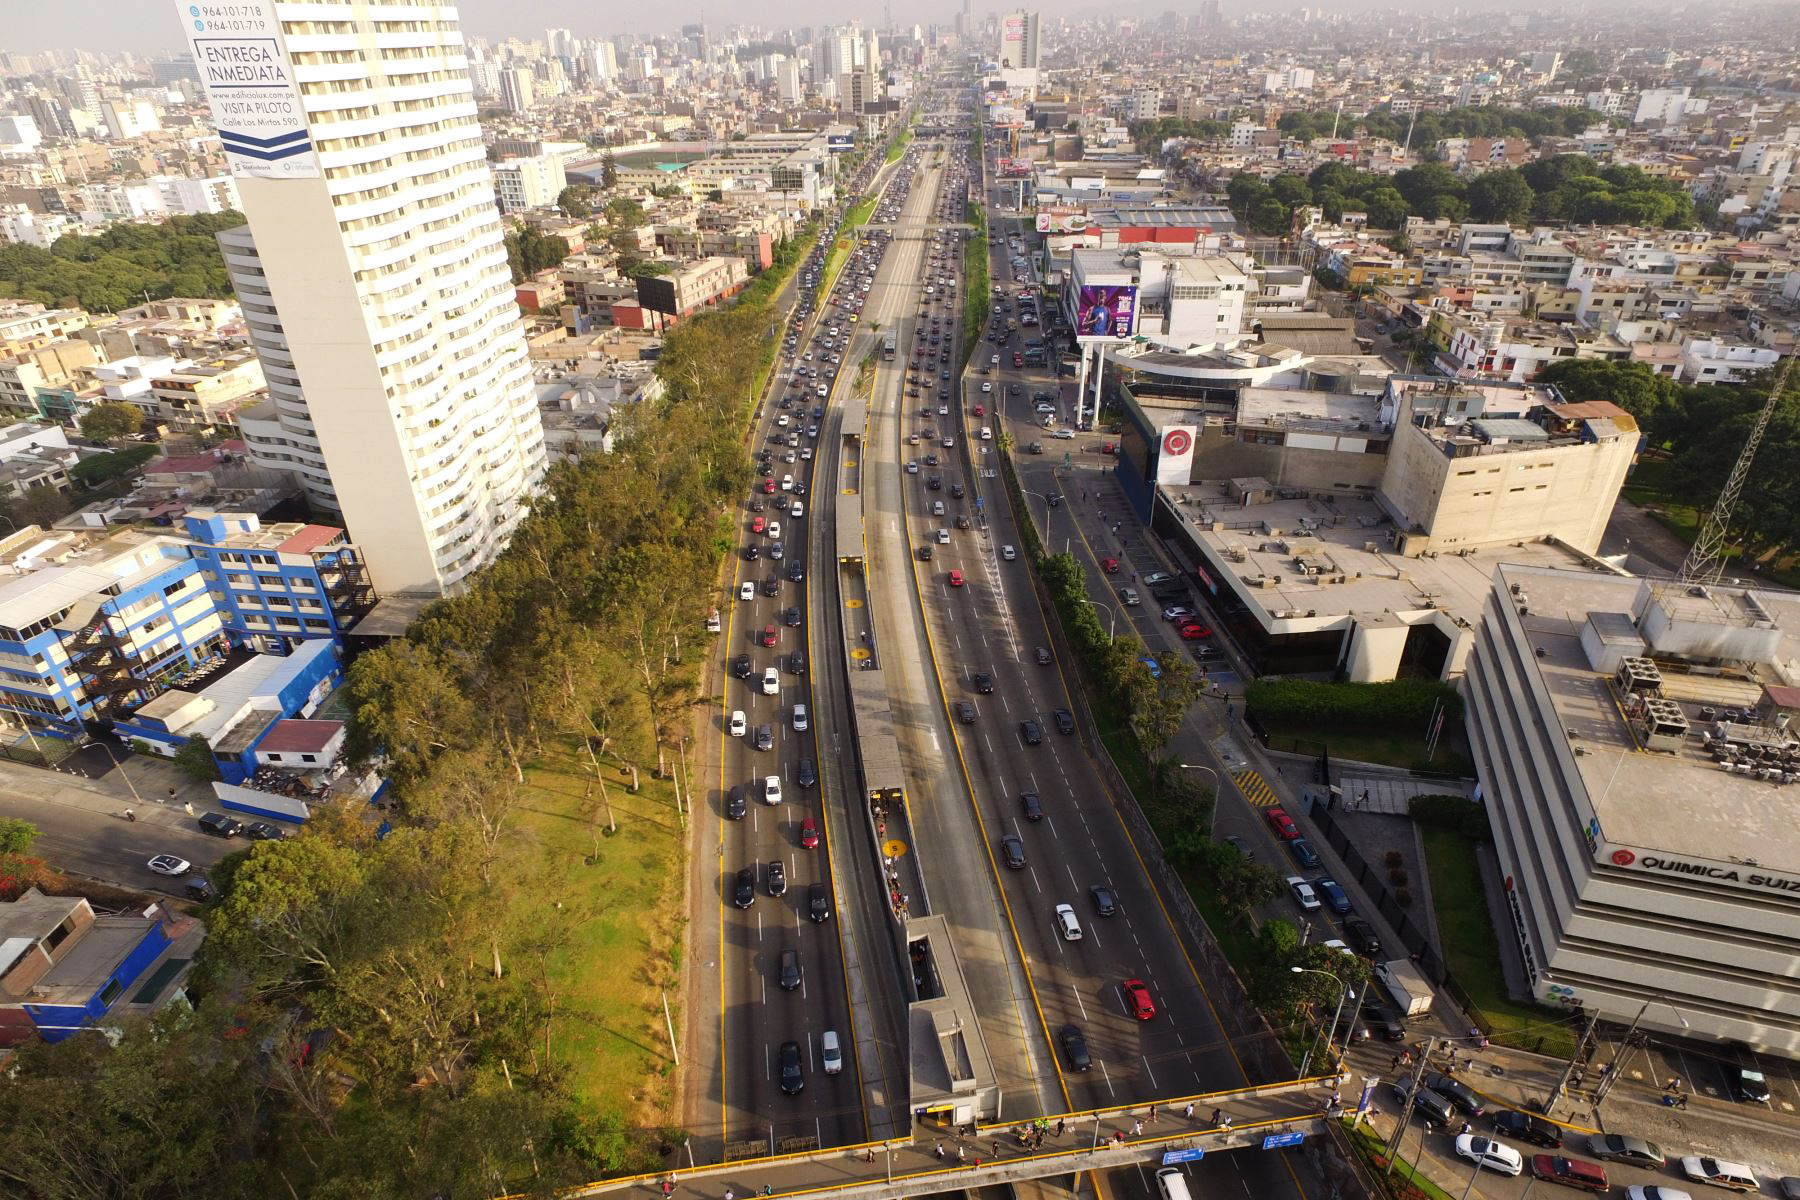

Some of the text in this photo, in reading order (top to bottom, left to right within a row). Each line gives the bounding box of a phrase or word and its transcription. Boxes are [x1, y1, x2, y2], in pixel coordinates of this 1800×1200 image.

[202, 6, 262, 17] 964-101-718
[206, 20, 265, 31] 964-101-719
[205, 46, 273, 63] ENTREGA
[206, 65, 287, 81] INMEDIATA
[220, 102, 292, 114] VISITA PILOTO
[222, 117, 299, 127] Calle Los Mirtos 590
[1641, 856, 1740, 882] QUIMICA
